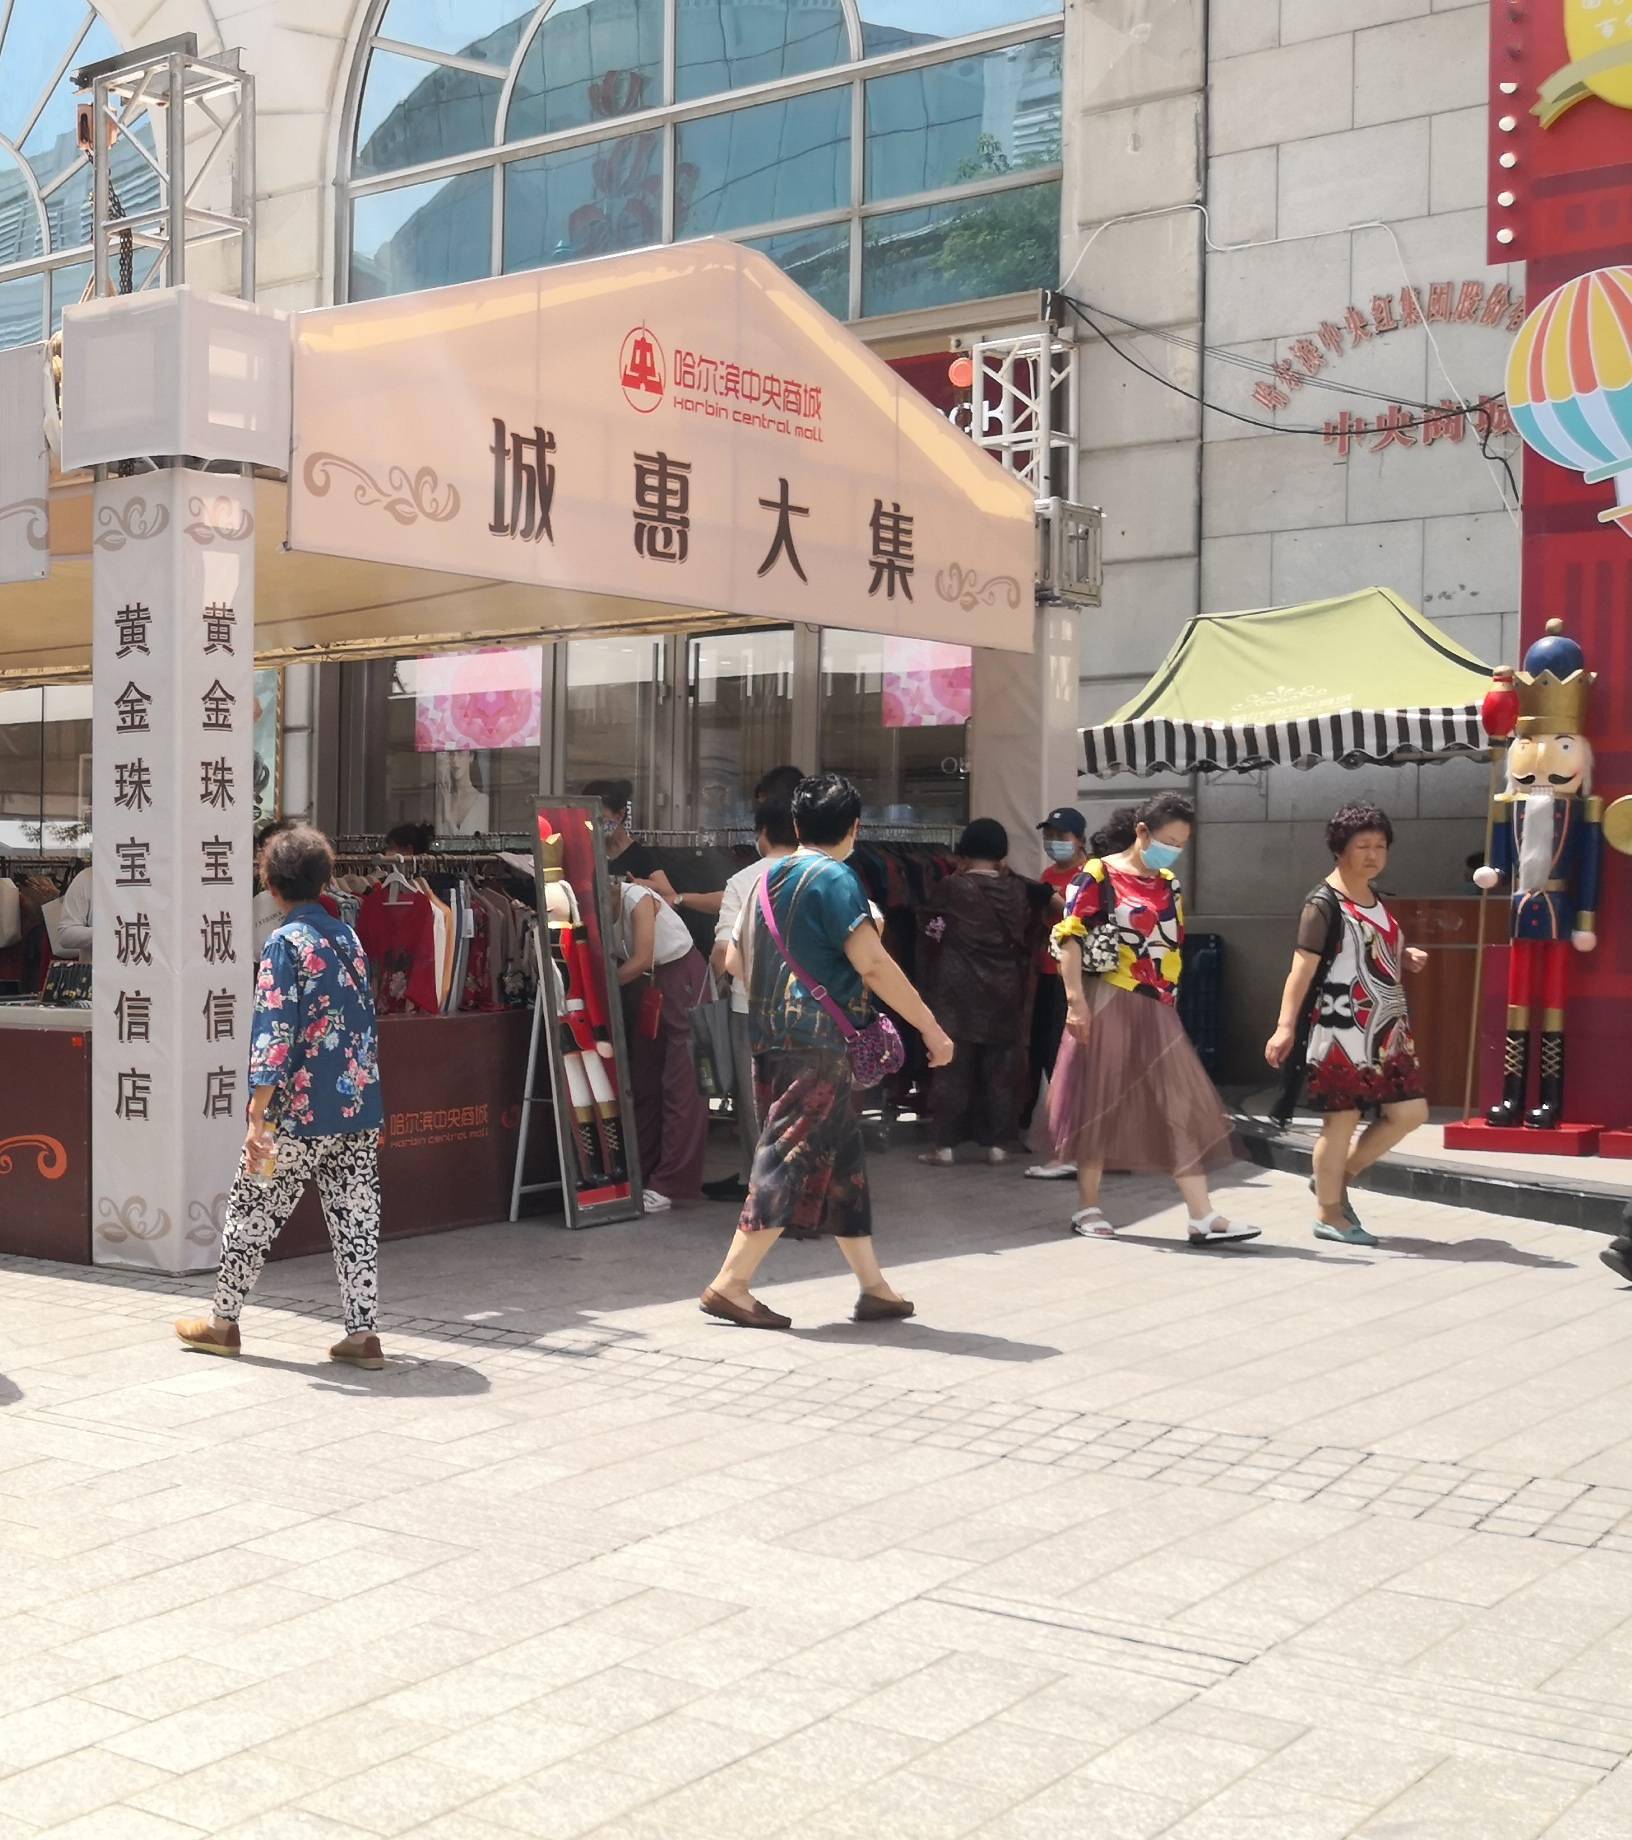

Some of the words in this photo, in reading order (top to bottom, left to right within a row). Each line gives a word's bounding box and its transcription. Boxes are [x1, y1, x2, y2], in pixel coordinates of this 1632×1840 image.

[673, 349, 822, 420] 哈尔滨中央商城
[673, 396, 729, 420] Harbin
[732, 409, 791, 435] central
[794, 426, 824, 442] mall
[488, 417, 916, 602] 城惠大集
[113, 603, 153, 1121] 黄金珠宝诚信店
[200, 601, 238, 1120] 黄金珠宝诚信店
[390, 1103, 488, 1136] 哈尔滨中央商城
